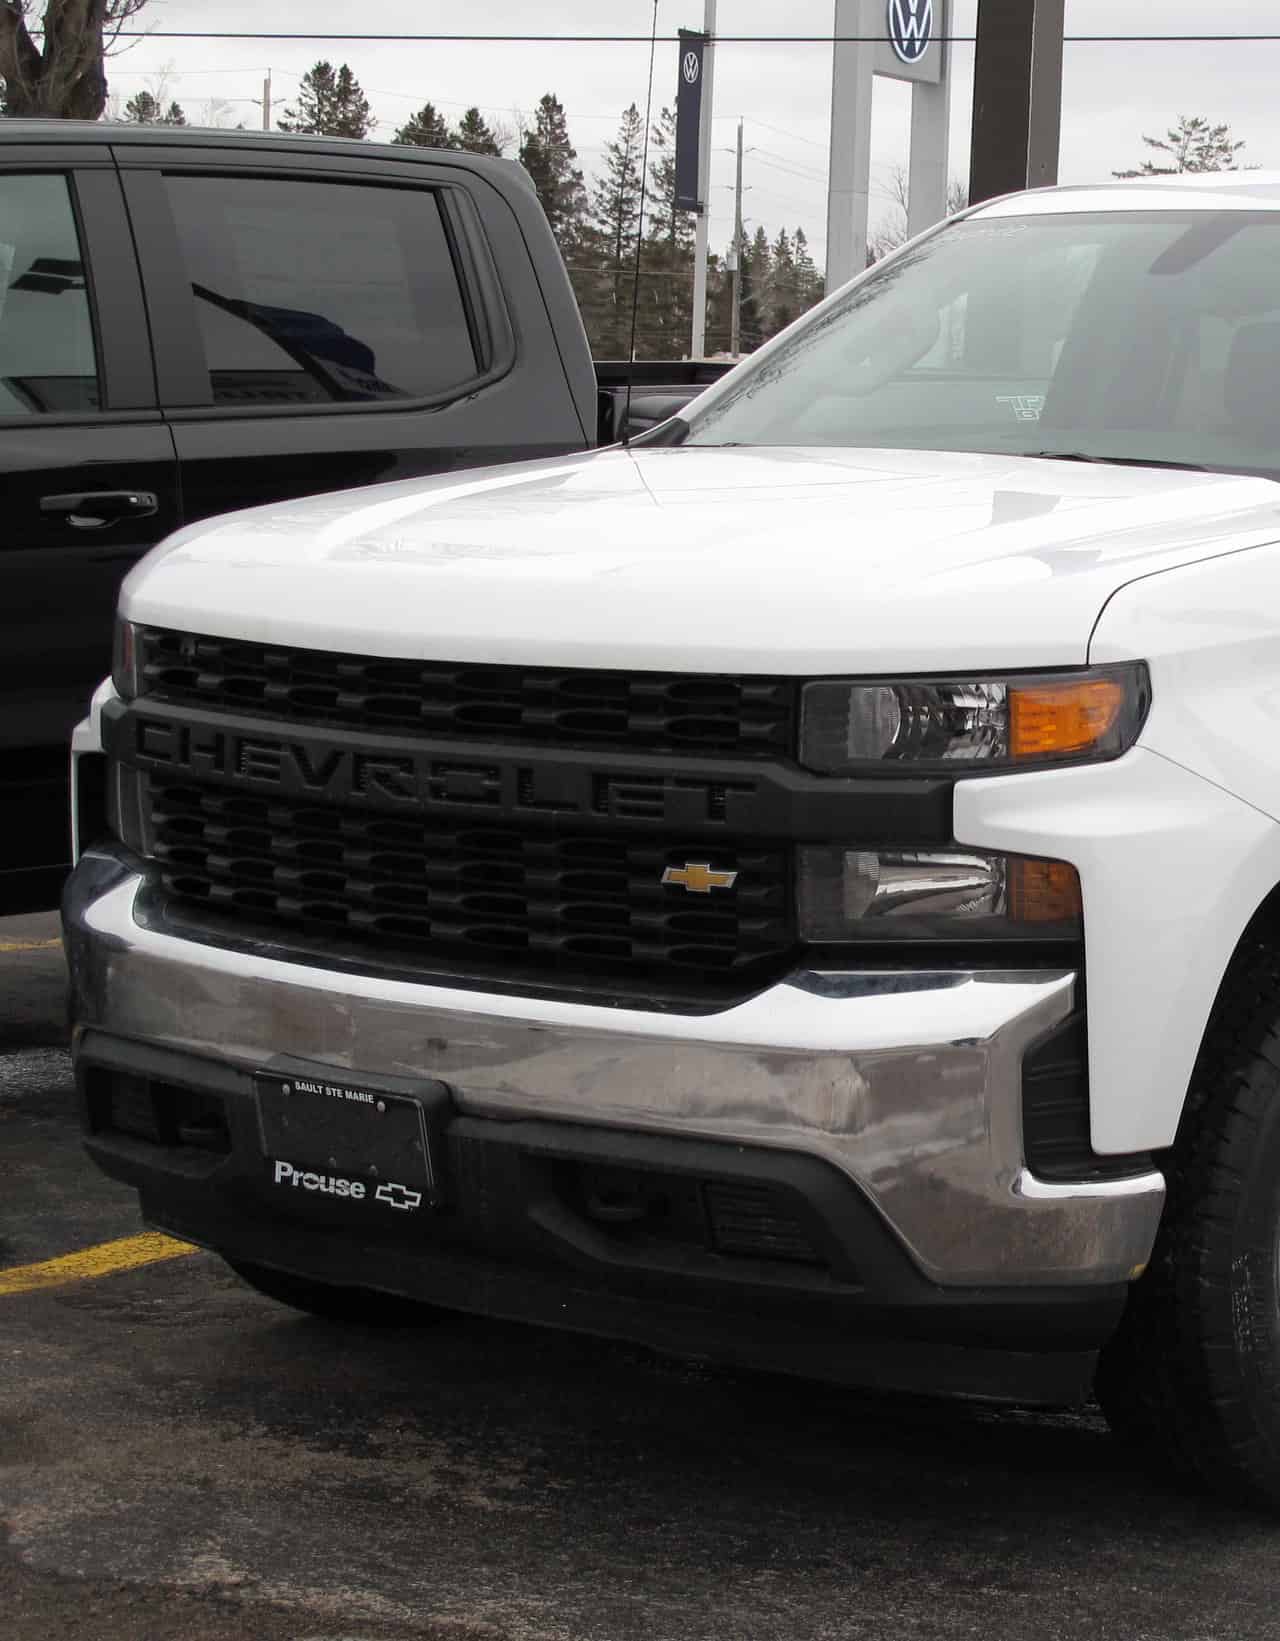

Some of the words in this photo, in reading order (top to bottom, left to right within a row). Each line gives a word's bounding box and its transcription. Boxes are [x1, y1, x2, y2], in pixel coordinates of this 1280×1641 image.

[136, 718, 756, 824] CHEVROLET
[295, 1081, 323, 1094] SAULT
[326, 1087, 343, 1098] STE
[345, 1090, 374, 1103] MARIE
[274, 1160, 366, 1199] Prouse
